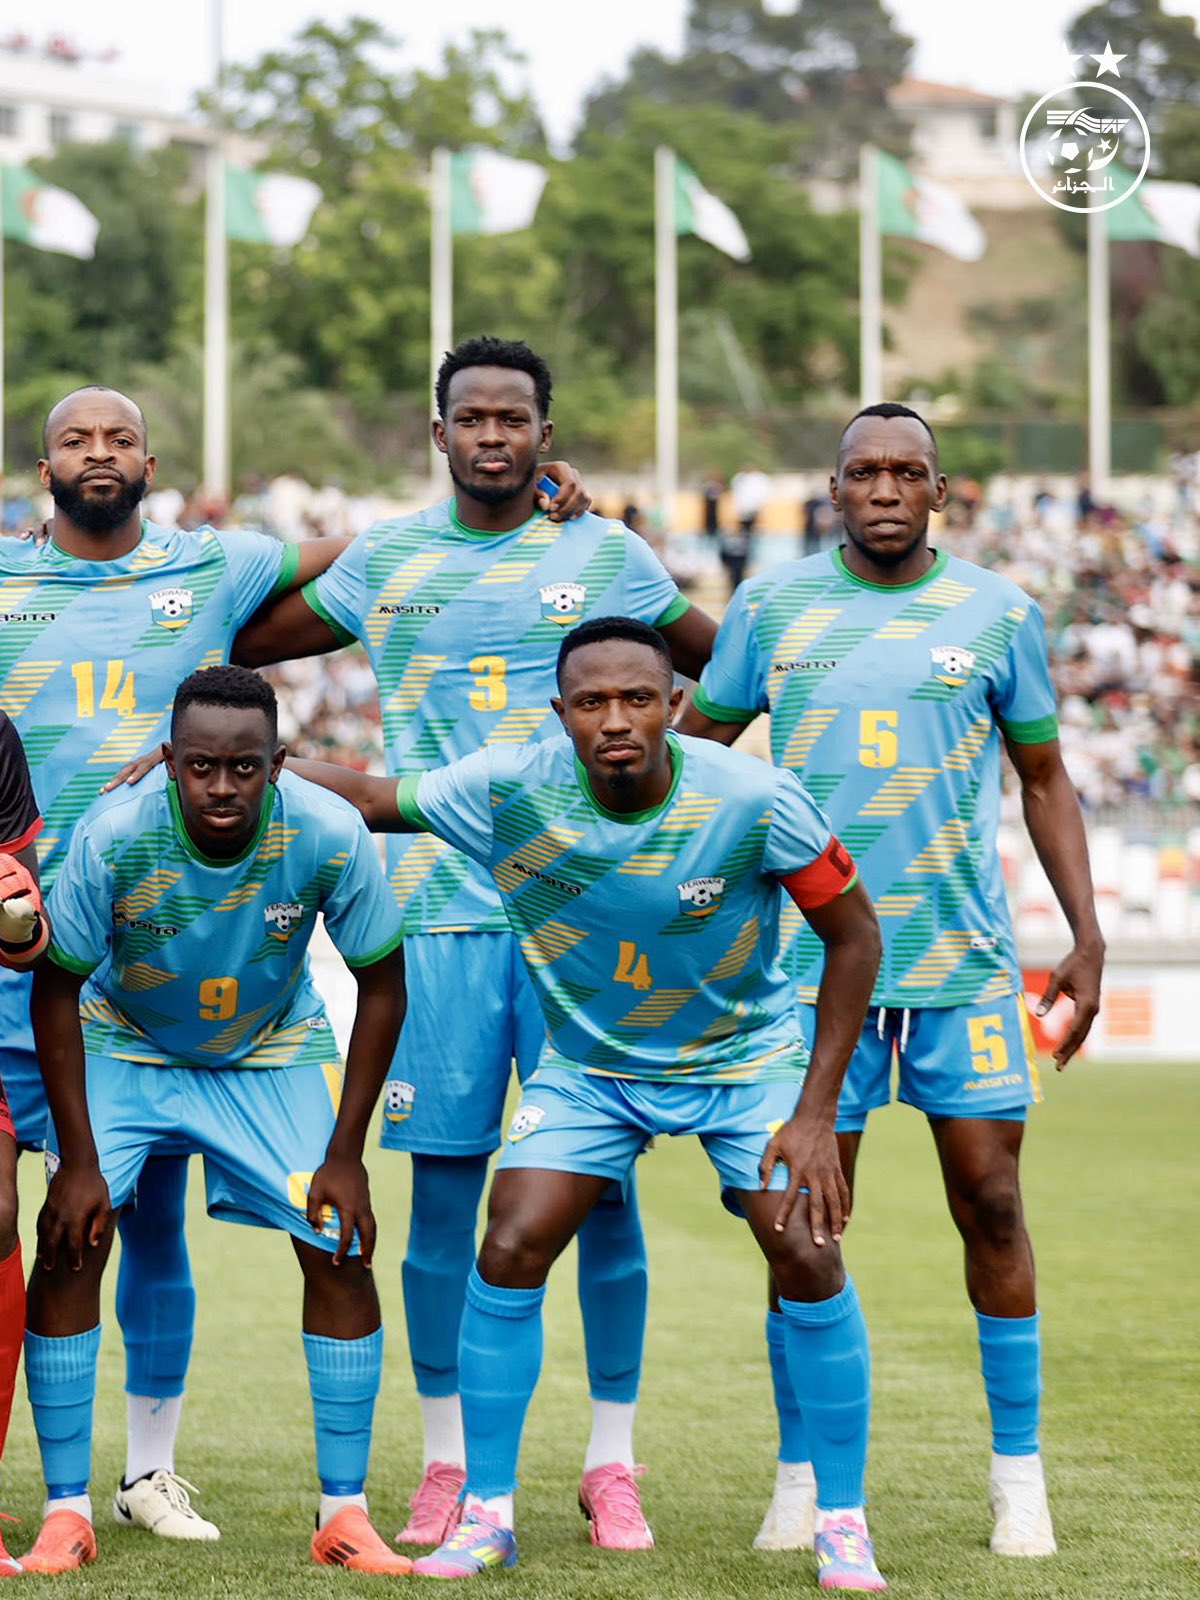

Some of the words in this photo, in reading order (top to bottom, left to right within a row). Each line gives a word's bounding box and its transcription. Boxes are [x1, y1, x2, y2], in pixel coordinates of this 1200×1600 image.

[71, 659, 137, 718] 14
[468, 656, 508, 712] 3
[859, 710, 899, 769] 5
[612, 940, 653, 990] 4
[199, 976, 239, 1021] 9
[966, 1013, 1009, 1075] 5
